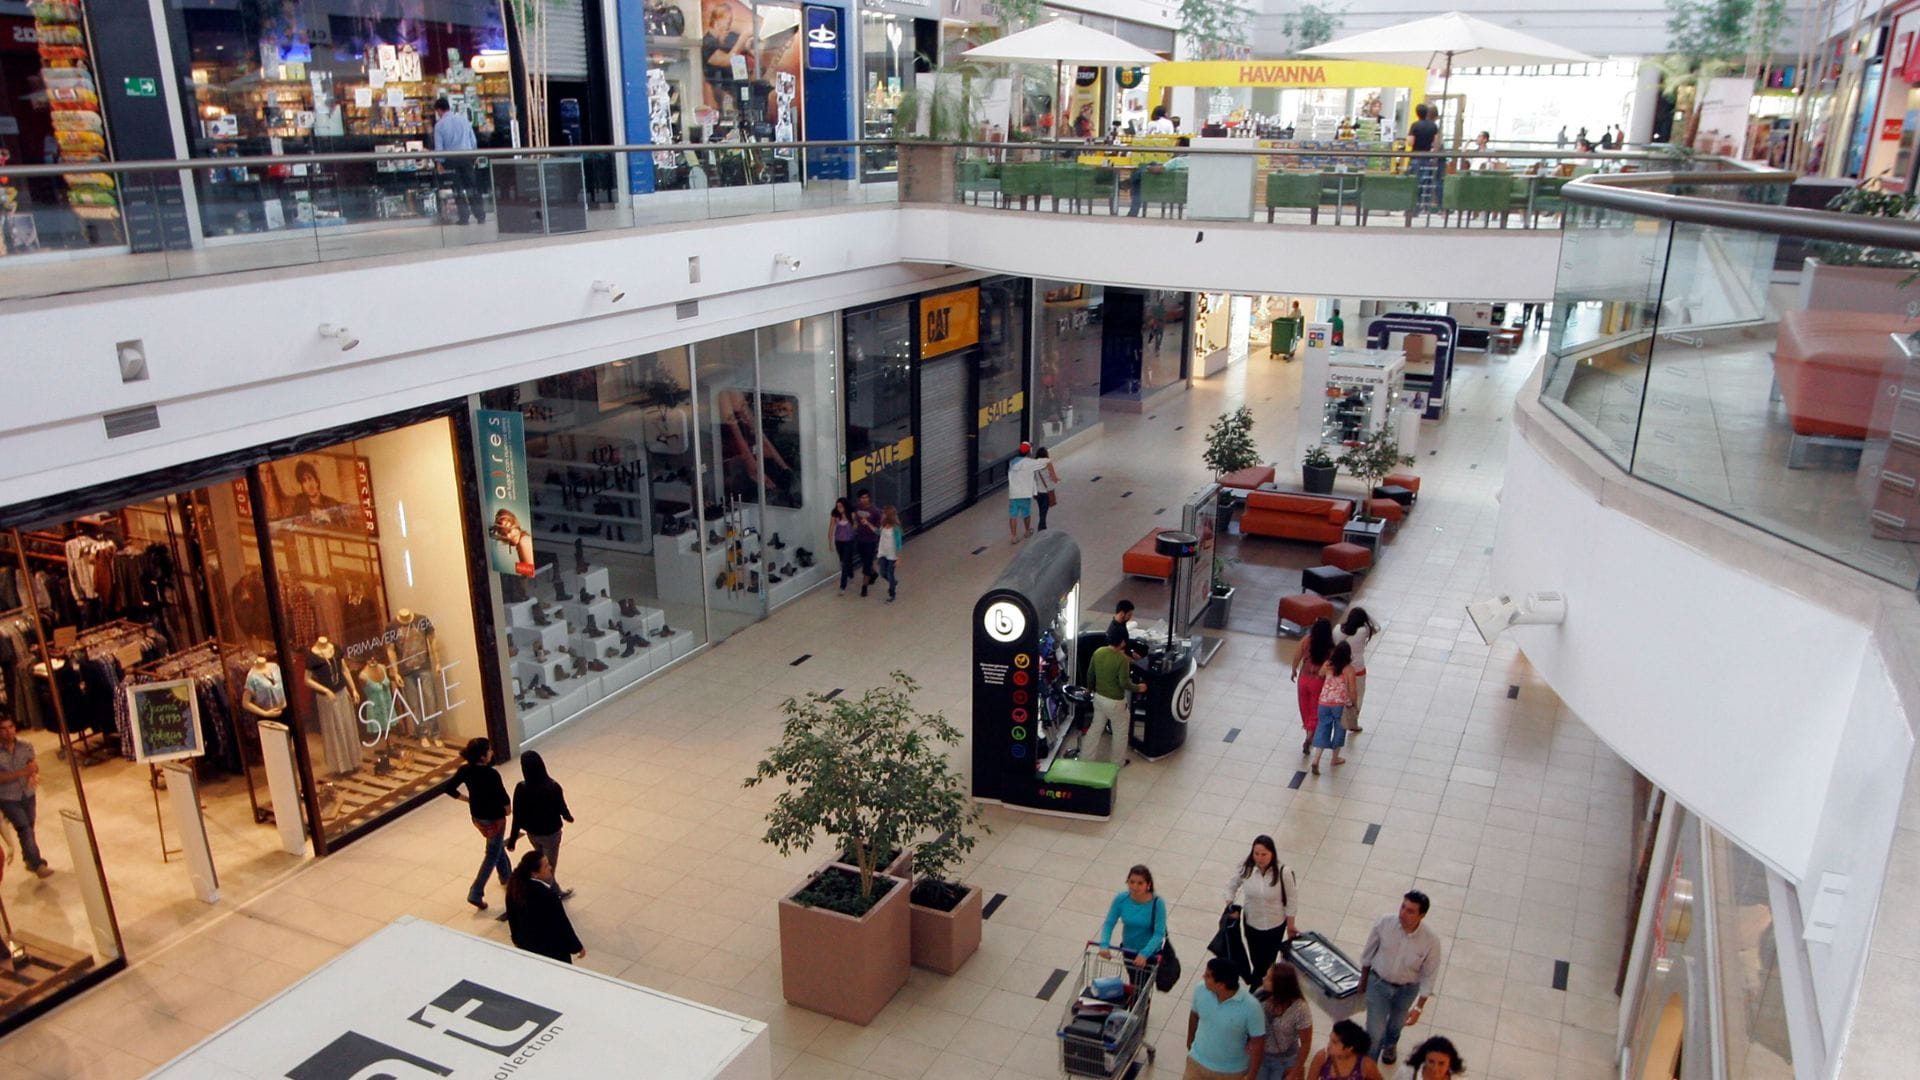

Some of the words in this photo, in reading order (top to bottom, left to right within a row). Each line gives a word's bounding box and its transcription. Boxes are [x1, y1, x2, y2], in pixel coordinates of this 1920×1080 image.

[1239, 65, 1326, 83] HAVANNA
[927, 306, 951, 343] CAT
[1331, 373, 1353, 382] Centro
[1355, 374, 1364, 382] de
[988, 395, 1013, 424] SALE
[488, 417, 507, 500] aires
[864, 443, 899, 476] SALE
[995, 608, 1014, 636] b
[346, 630, 404, 658] PRIMAVERA
[358, 660, 466, 748] SALE
